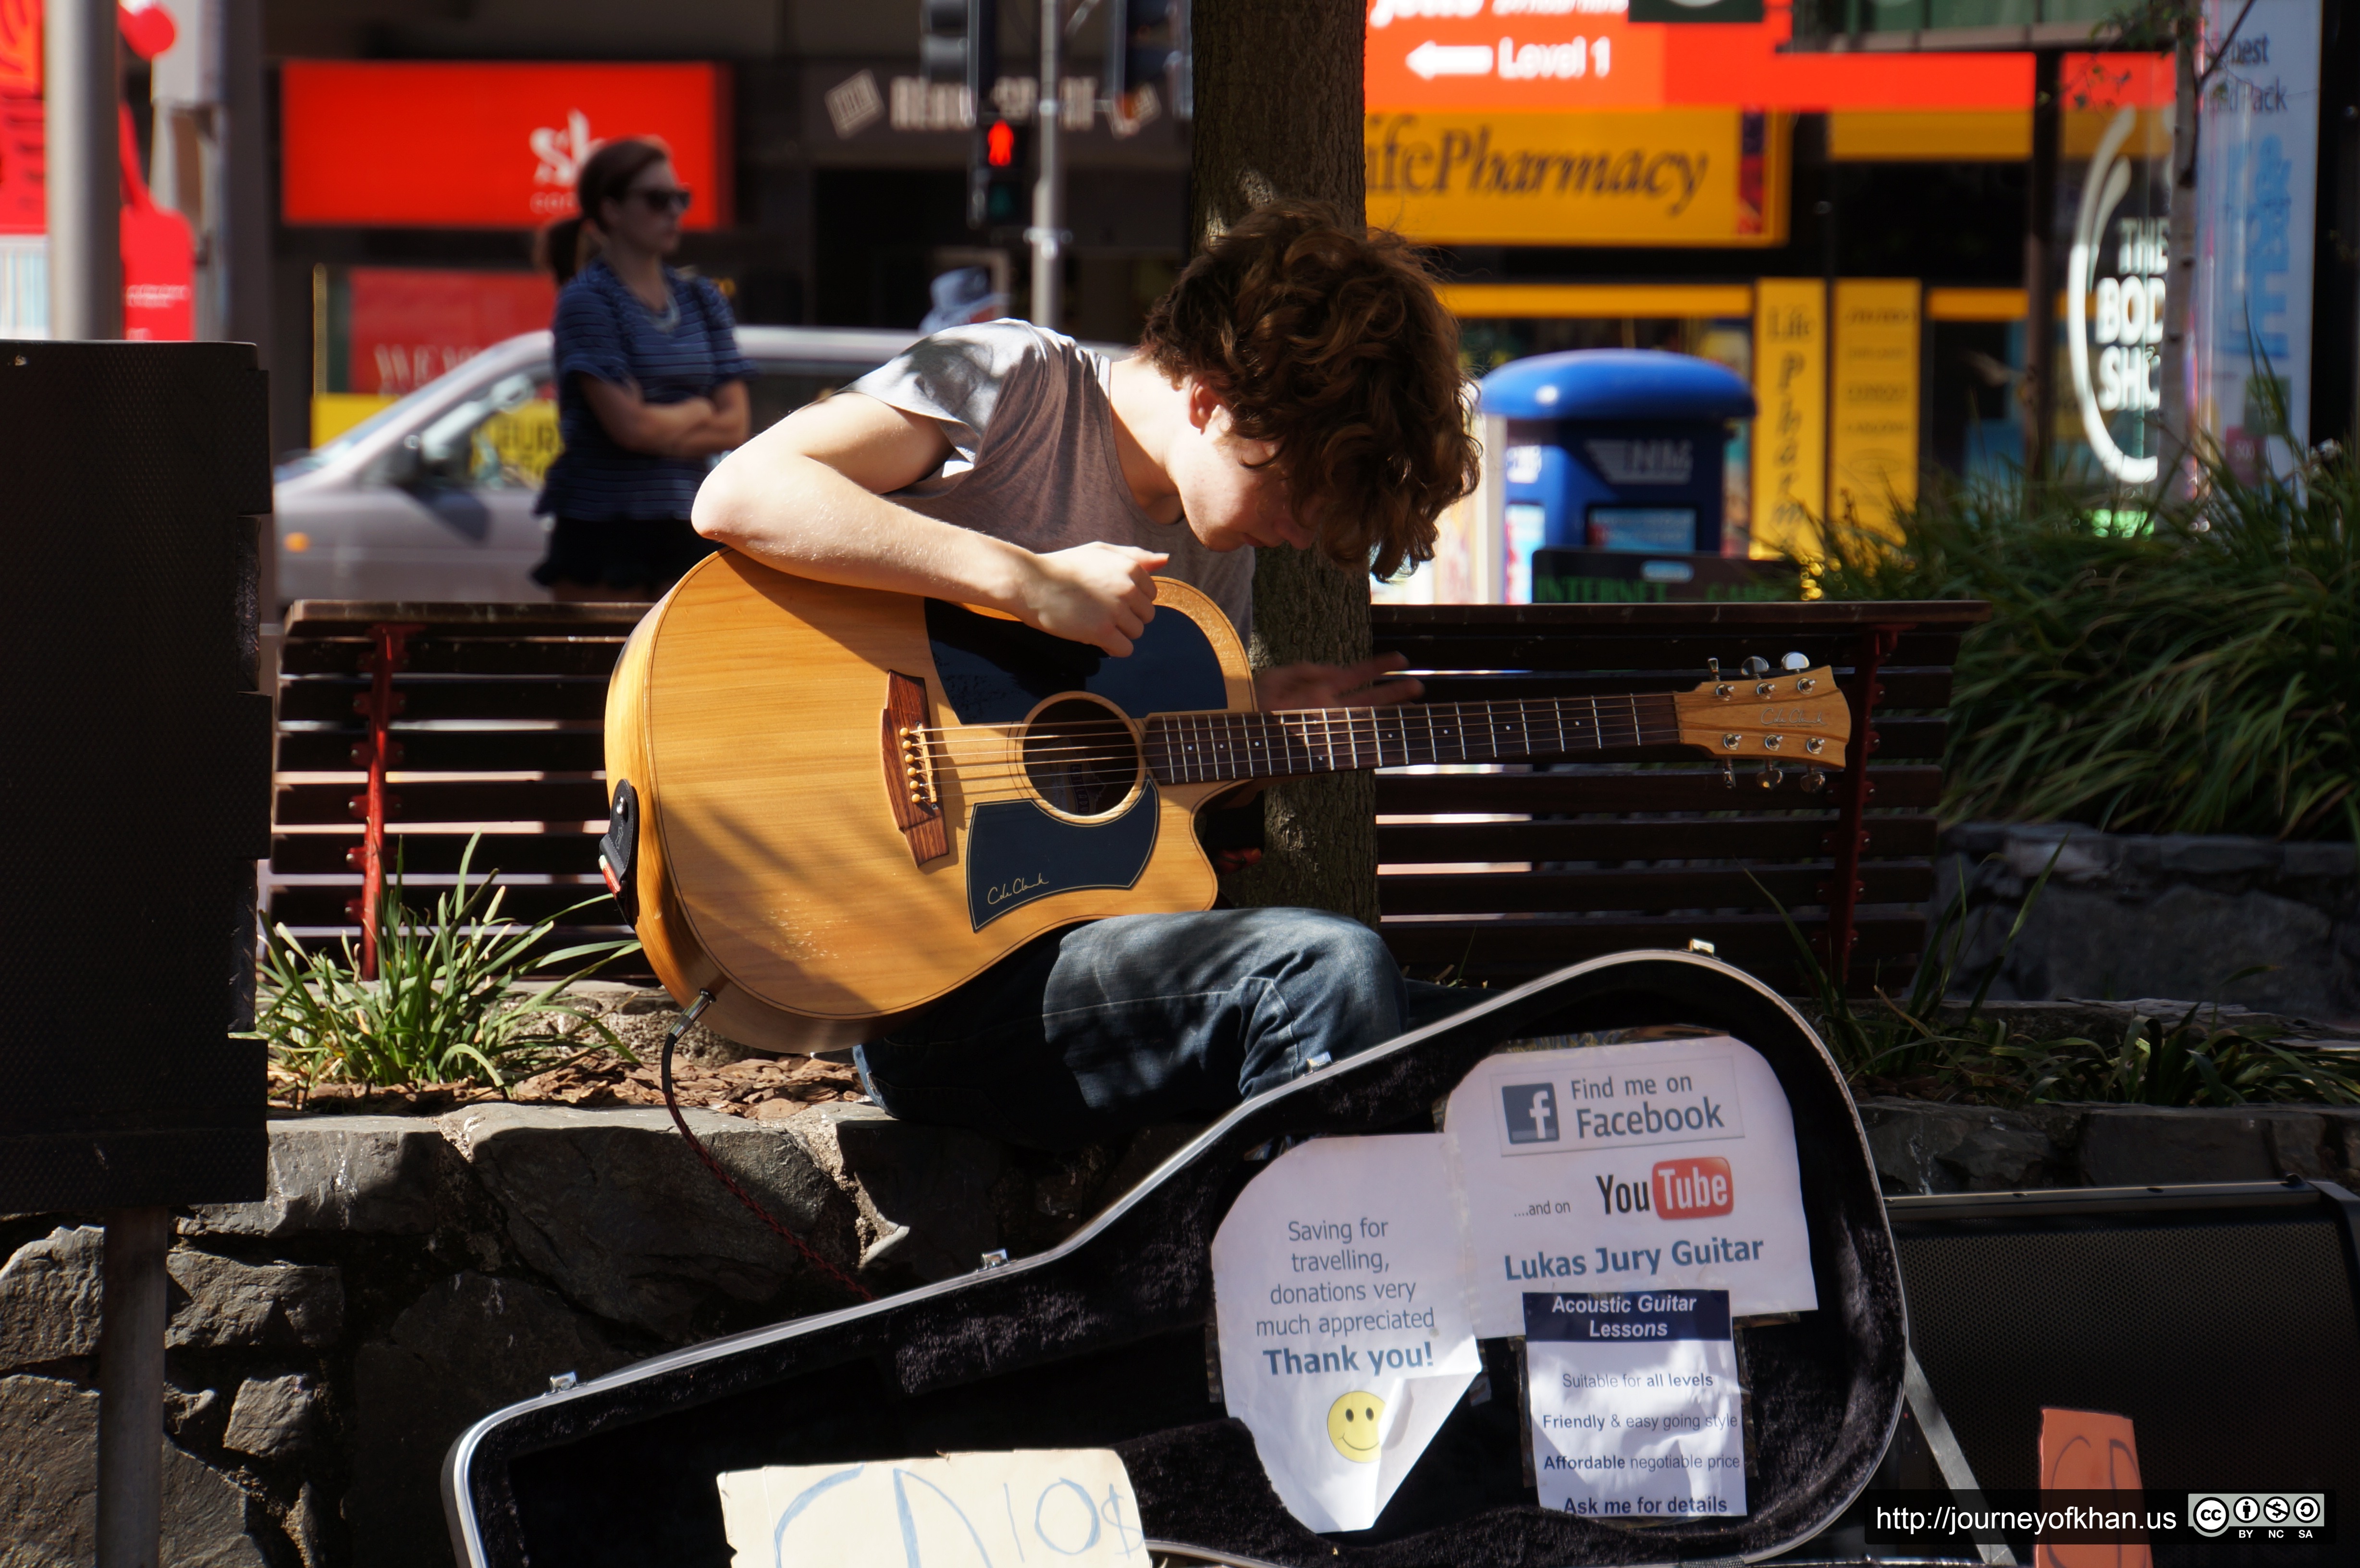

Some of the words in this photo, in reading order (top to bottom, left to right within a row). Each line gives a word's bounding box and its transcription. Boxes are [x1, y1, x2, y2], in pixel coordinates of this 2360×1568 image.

[1498, 36, 1586, 79] Level
[1590, 37, 1610, 77] 1
[1365, 113, 1710, 218] ifePharmacy
[2118, 218, 2169, 274] THE
[2096, 276, 2166, 346] BOD
[1571, 1076, 1614, 1100] Find
[1624, 1079, 1656, 1096] me
[1667, 1077, 1692, 1093] on
[1576, 1096, 1725, 1139] Facebook
[1555, 1200, 1571, 1214] on
[1288, 1219, 1353, 1244] Saving
[1360, 1217, 1389, 1237] for
[1291, 1250, 1390, 1274] travelling,
[1504, 1251, 1587, 1281] Lukas
[1596, 1247, 1662, 1275] Jury
[1671, 1237, 1764, 1266] Guitar
[1270, 1281, 1366, 1305] donations
[1373, 1281, 1417, 1303] very
[1551, 1295, 1631, 1313] Acoustic
[1637, 1294, 1697, 1312] Guitar
[1256, 1312, 1311, 1337] much
[1318, 1306, 1435, 1337] appreciated
[1589, 1320, 1668, 1337] Lessons
[1262, 1344, 1359, 1376] Thank
[1367, 1341, 1434, 1377] you!
[1562, 1373, 1618, 1388] Suitable
[1622, 1373, 1641, 1387] for
[1647, 1373, 1664, 1387] all
[1668, 1372, 1714, 1387] levels
[1542, 1414, 1606, 1432] Friendly
[1610, 1413, 1621, 1429] &
[1626, 1415, 1659, 1432] easy
[1663, 1414, 1700, 1432] going
[1705, 1413, 1738, 1431] style
[1543, 1455, 1626, 1470] Affordable
[1630, 1454, 1703, 1472] negotiable
[1707, 1455, 1740, 1471] price
[1563, 1497, 1598, 1515] Ask
[1604, 1500, 1632, 1514] me
[1636, 1496, 1662, 1514] for
[1667, 1496, 1728, 1514] details
